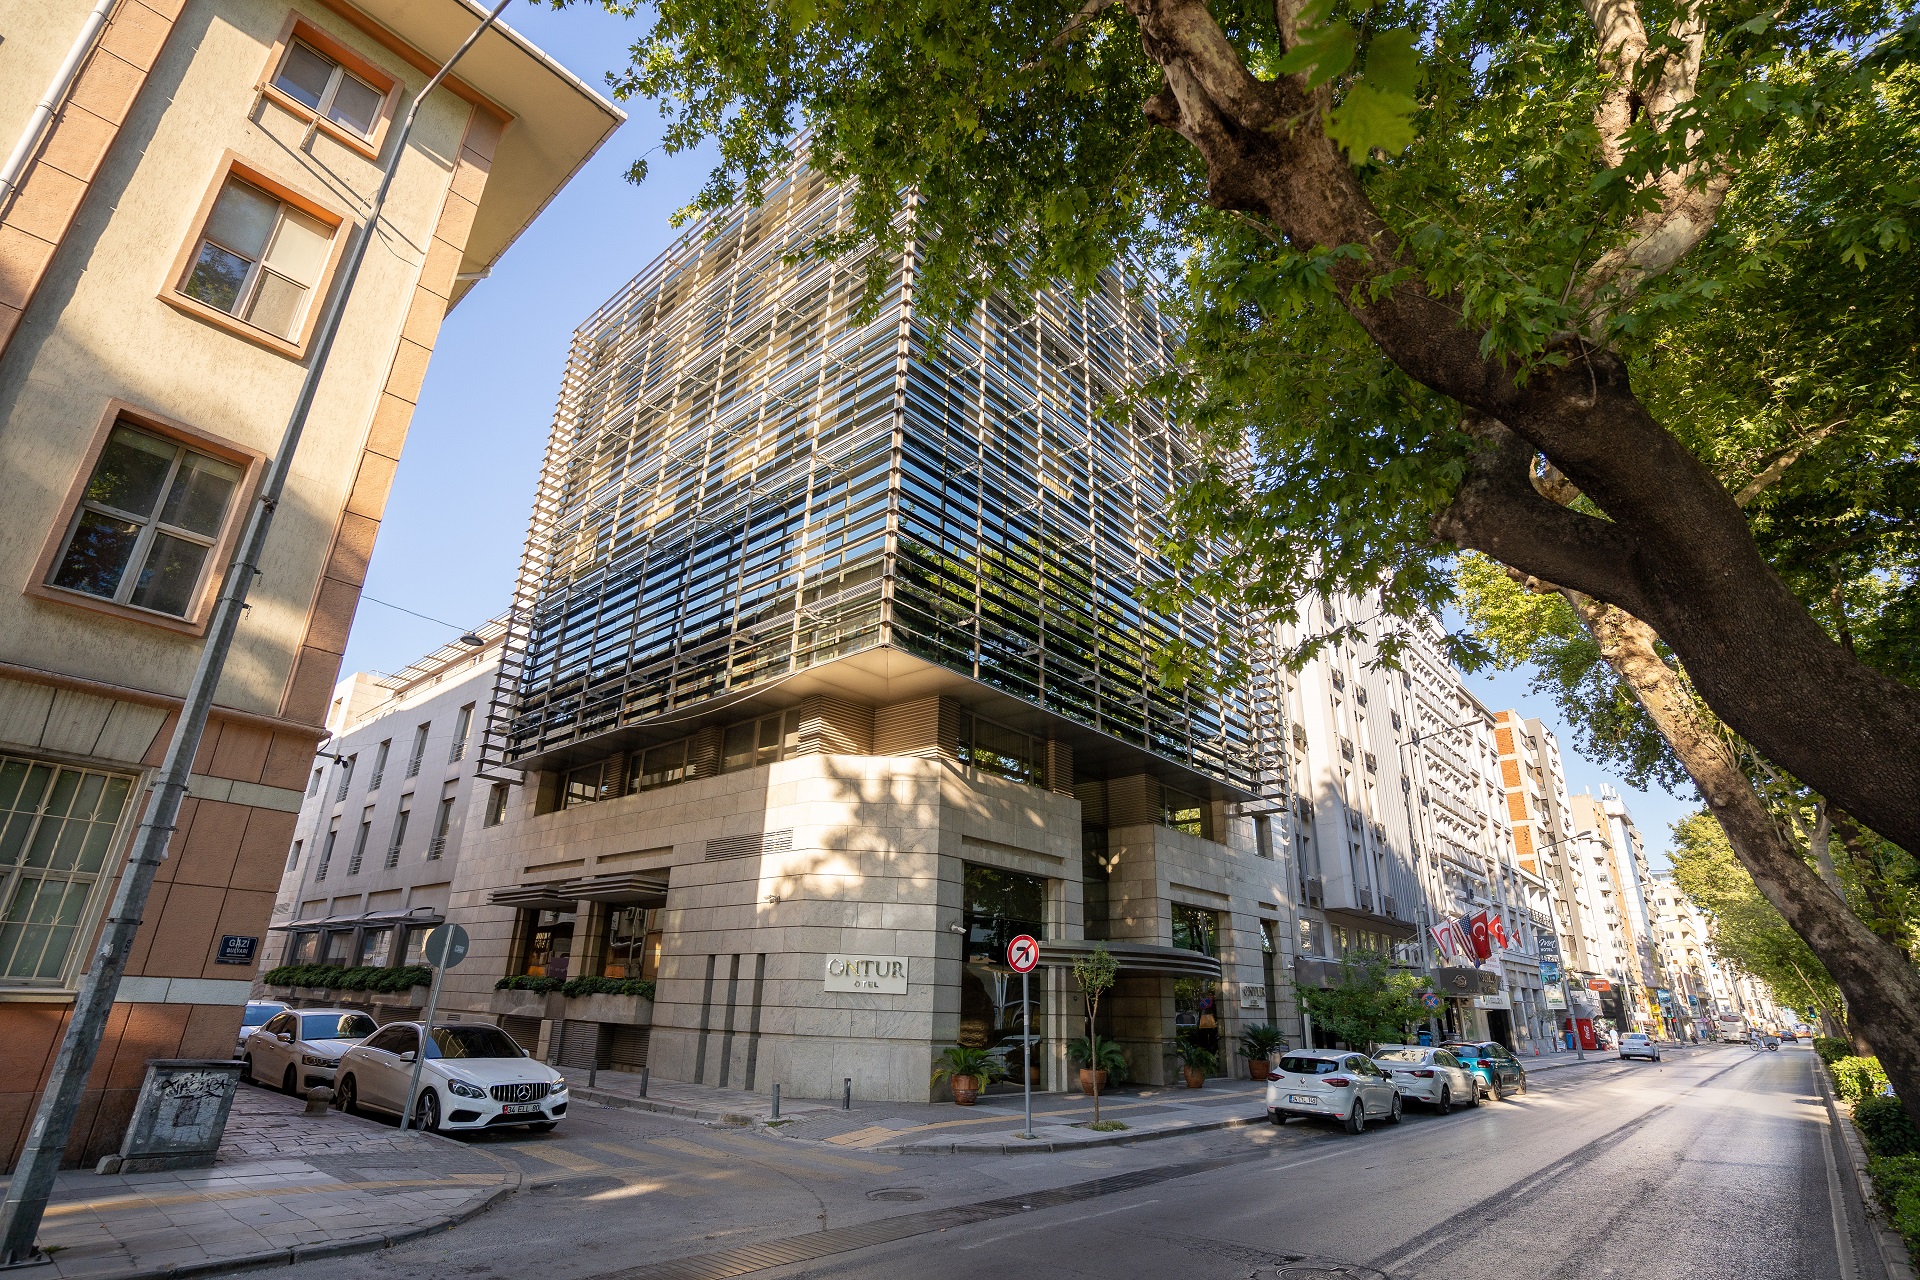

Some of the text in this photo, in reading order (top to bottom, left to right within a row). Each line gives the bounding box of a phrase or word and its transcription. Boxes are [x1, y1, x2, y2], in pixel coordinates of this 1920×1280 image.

[228, 938, 250, 947] GAZİ
[827, 958, 906, 978] ONTUR
[854, 980, 879, 989] OTEL
